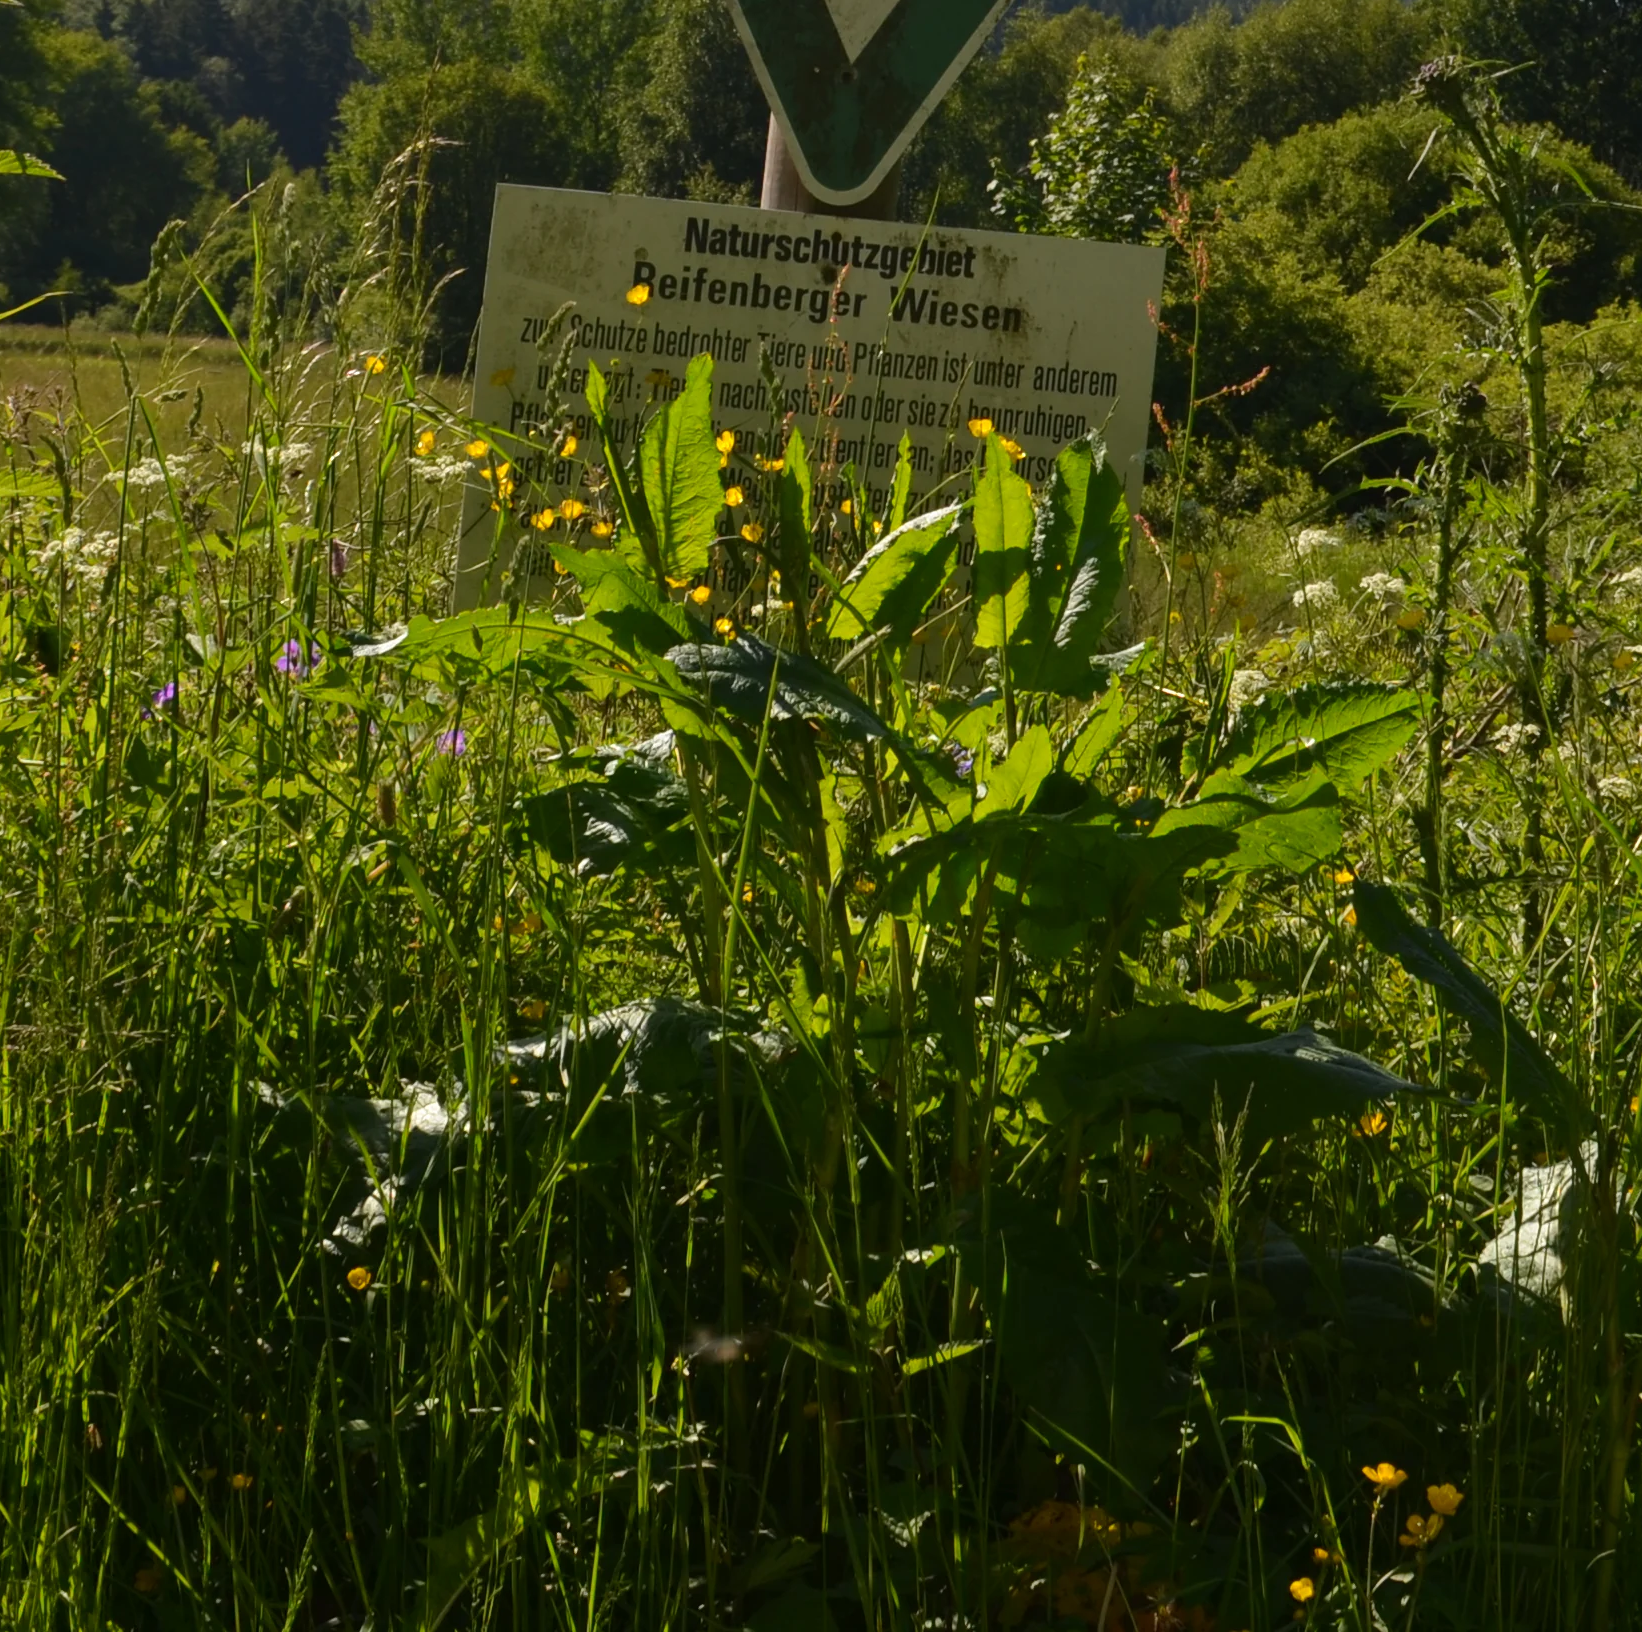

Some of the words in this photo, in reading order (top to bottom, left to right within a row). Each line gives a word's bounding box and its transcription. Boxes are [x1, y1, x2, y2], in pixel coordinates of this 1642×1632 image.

[683, 216, 976, 280] Naturschutzgebiet
[632, 260, 868, 325] Reifenberger
[889, 285, 1023, 334] Wiesen
[973, 355, 1026, 389] unter
[1033, 360, 1118, 397] anderem
[907, 393, 936, 428] sie
